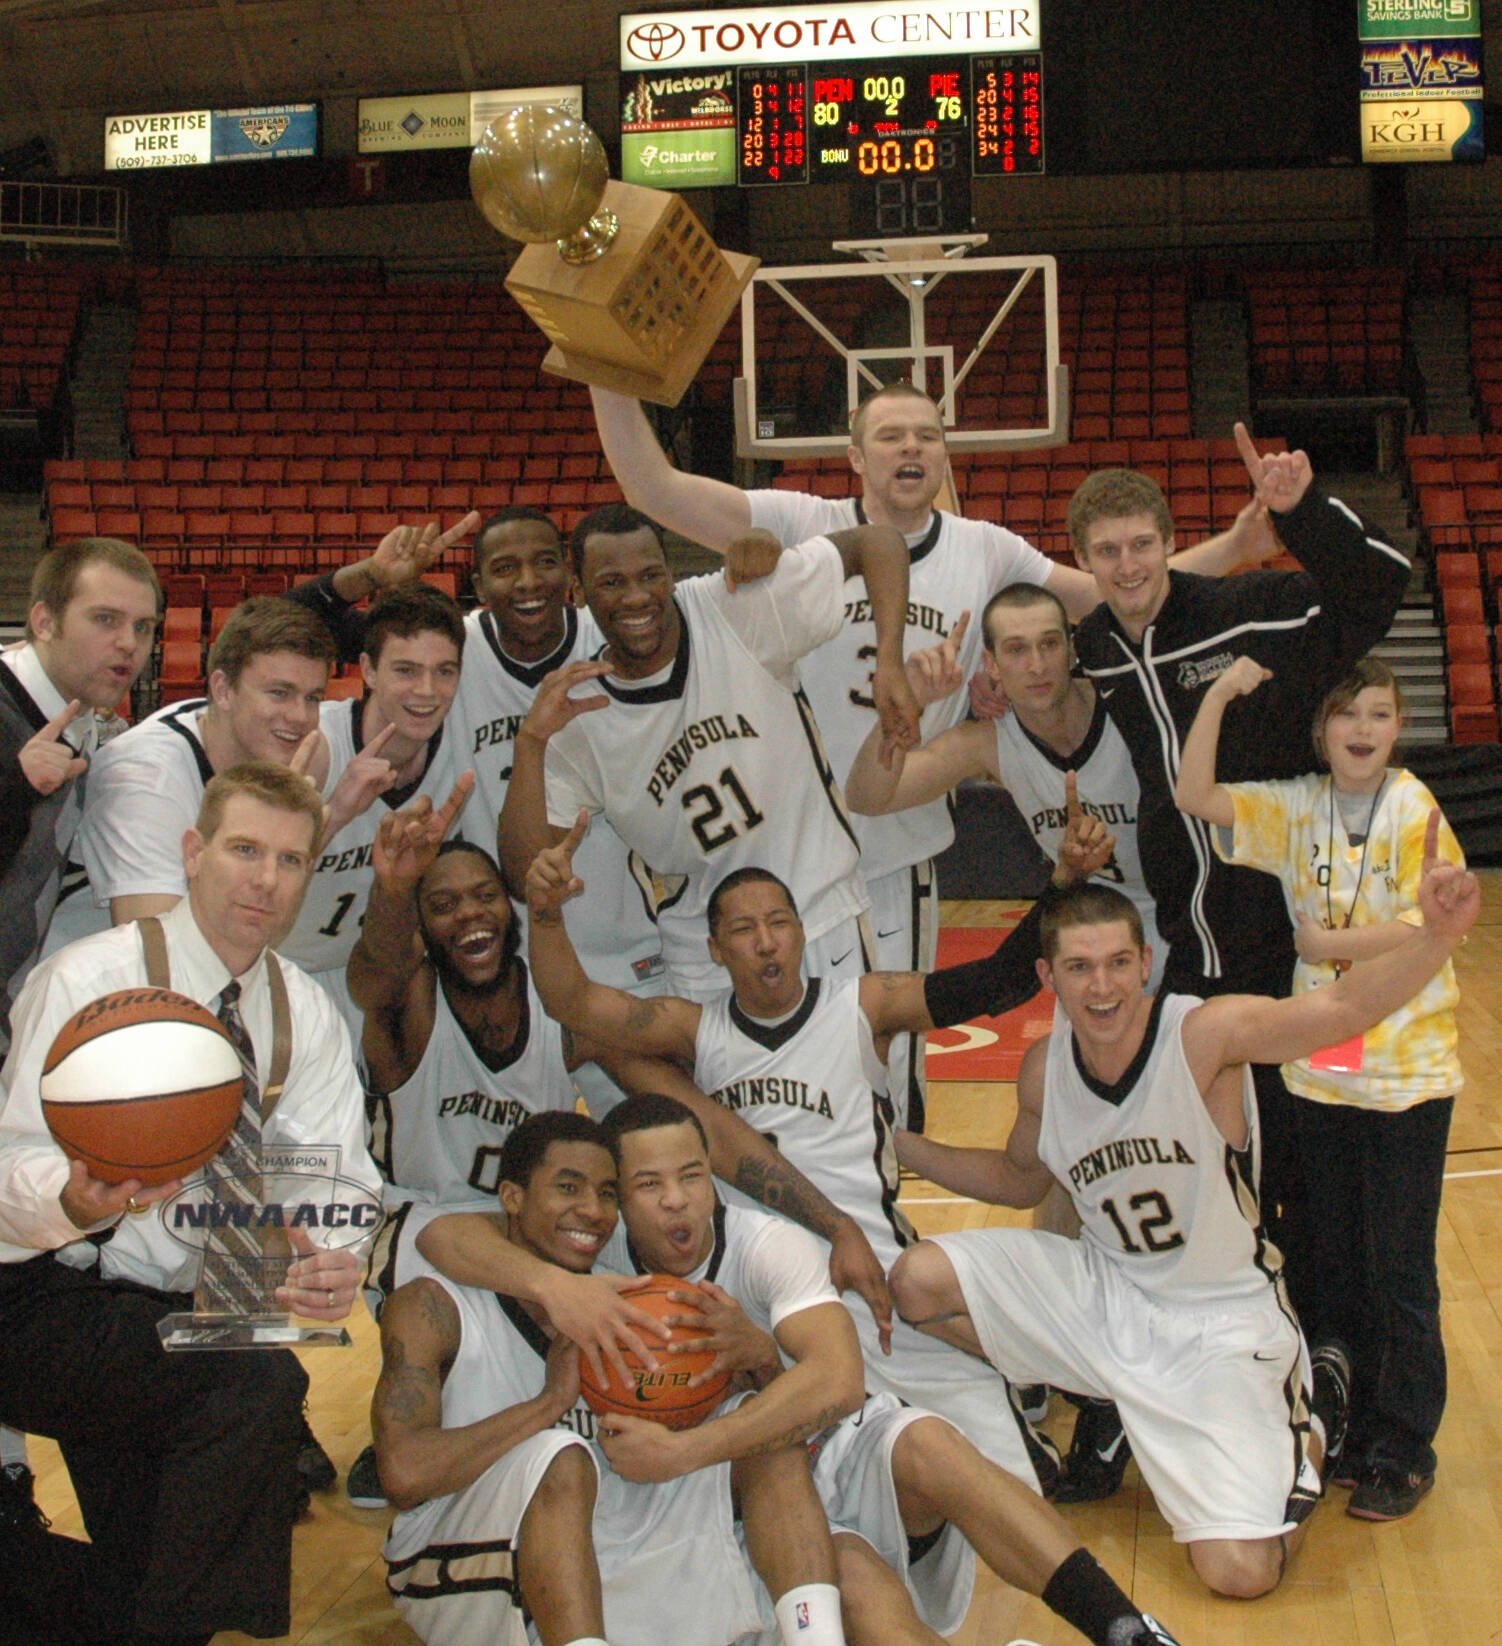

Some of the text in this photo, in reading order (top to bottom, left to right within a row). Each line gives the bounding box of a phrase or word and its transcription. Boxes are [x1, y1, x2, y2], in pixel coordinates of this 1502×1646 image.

[1367, 9, 1442, 21] SAVINGS BANK
[691, 8, 1033, 53] TOYOTA CENTER
[650, 70, 733, 96] Victory!
[987, 72, 997, 88] 5
[1004, 71, 1014, 87] 3
[753, 84, 763, 99] 0
[788, 82, 804, 97] 11
[863, 76, 905, 101] 00.0
[977, 89, 997, 104] 20
[1003, 89, 1014, 103] 4
[755, 100, 763, 115] 3
[814, 97, 961, 126] 80 2 76
[977, 106, 997, 122] 23
[109, 114, 206, 136] ADVERTISE
[748, 117, 763, 132] 12
[978, 123, 998, 138] 24
[1003, 122, 1014, 137] 4
[1370, 123, 1446, 143] KGH
[135, 135, 178, 151] HERE
[744, 133, 763, 149] 20
[979, 141, 999, 157] 34
[1003, 139, 1014, 155] 2
[116, 153, 198, 169] (509)-737-3706
[659, 150, 717, 164] Charter
[744, 151, 763, 166] 22
[774, 150, 780, 164] 1
[859, 138, 934, 175] 00.0
[680, 764, 765, 853] 21
[174, 1203, 379, 1229] NWAACC
[1101, 1189, 1186, 1253] 12
